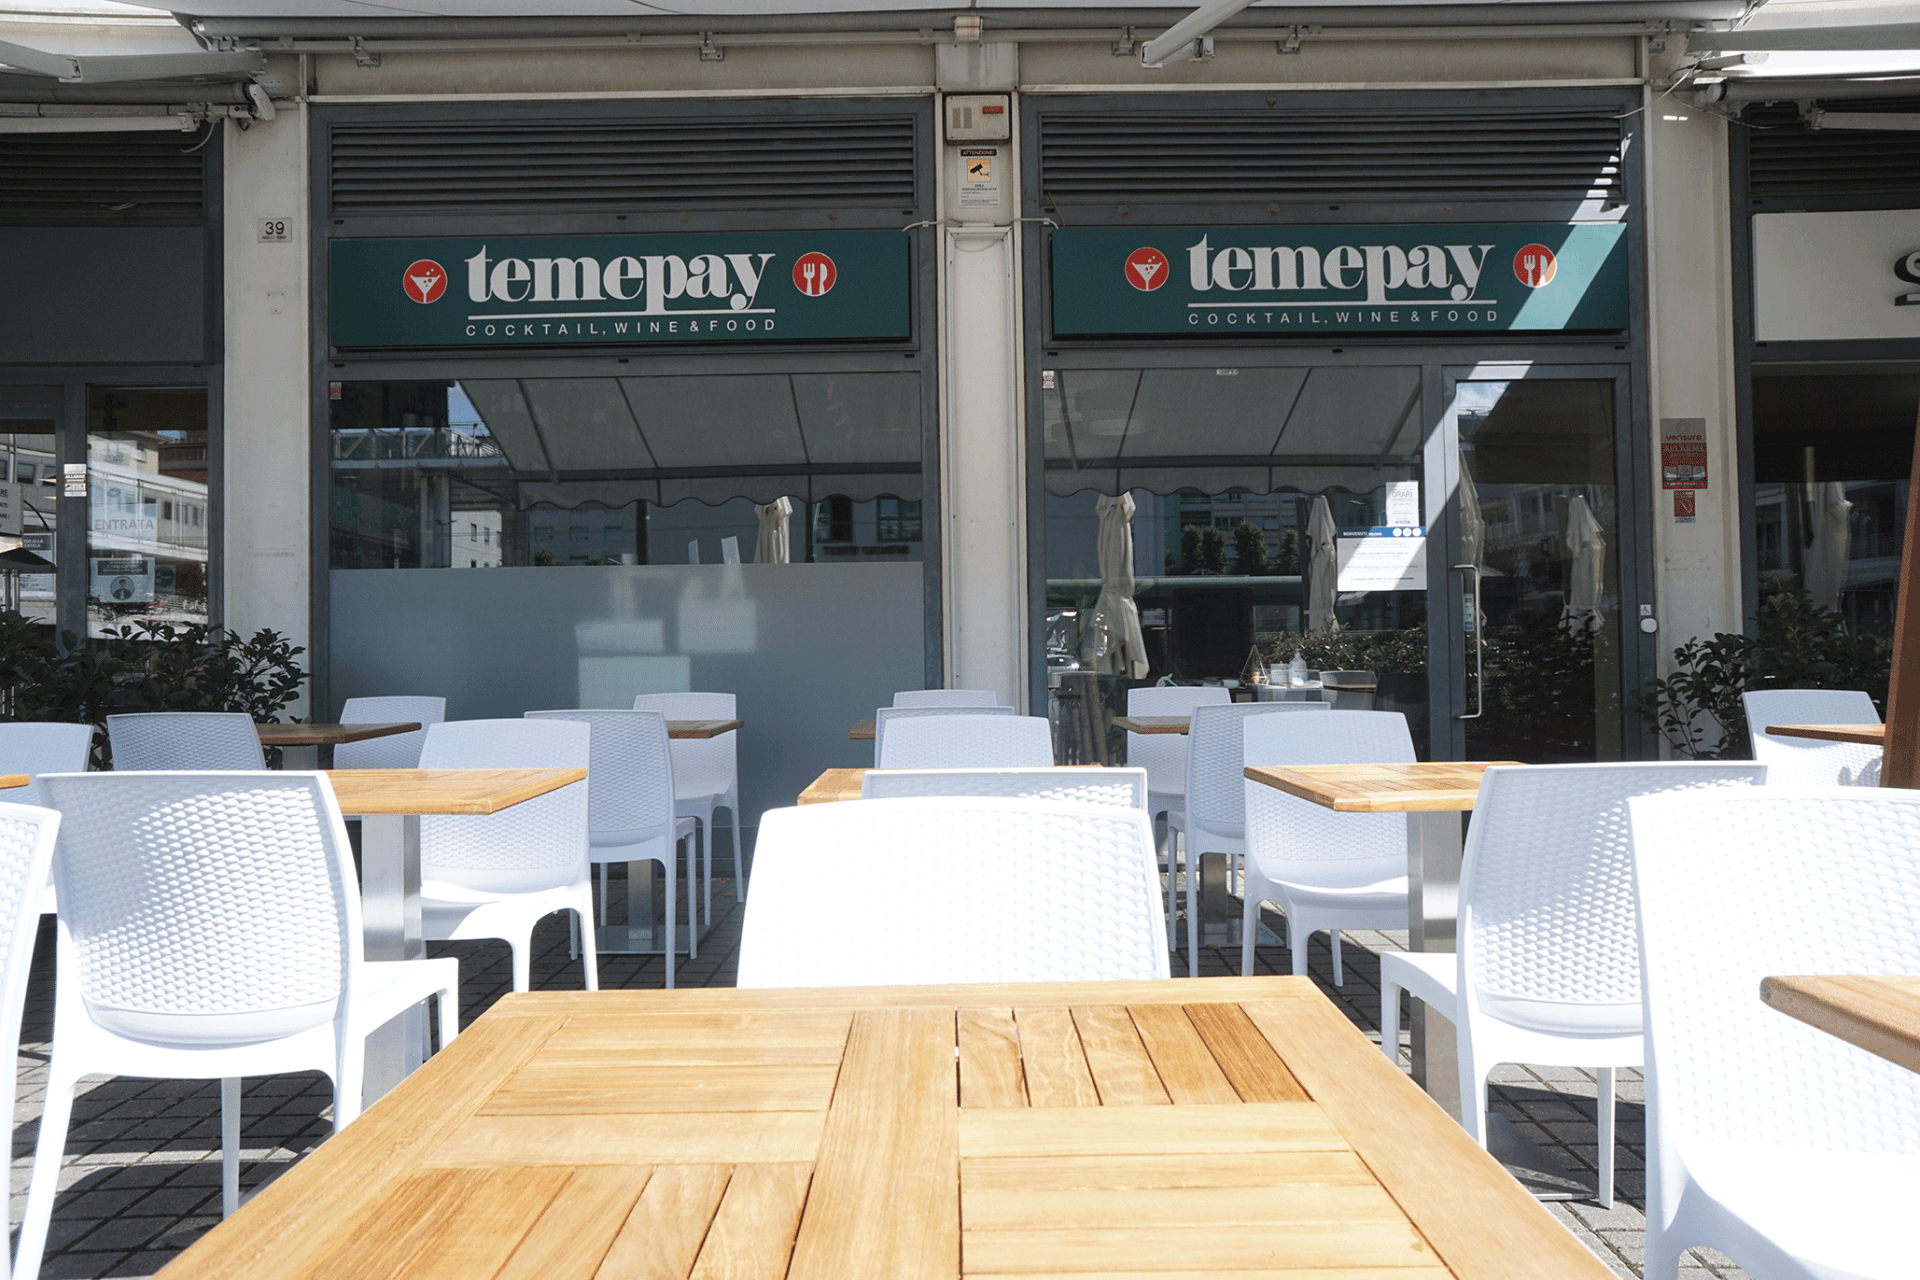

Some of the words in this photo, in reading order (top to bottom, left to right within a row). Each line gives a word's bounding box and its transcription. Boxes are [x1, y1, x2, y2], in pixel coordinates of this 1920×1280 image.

[265, 221, 285, 235] 39
[1186, 233, 1496, 302] temepay
[464, 244, 776, 312] temepay
[1336, 311, 1399, 323] WINE
[1410, 311, 1420, 322] &
[1431, 310, 1497, 322] FOOD
[614, 321, 678, 334] WINE
[689, 320, 699, 333] &
[709, 319, 775, 331] FOOD
[94, 519, 154, 530] ENTRATA
